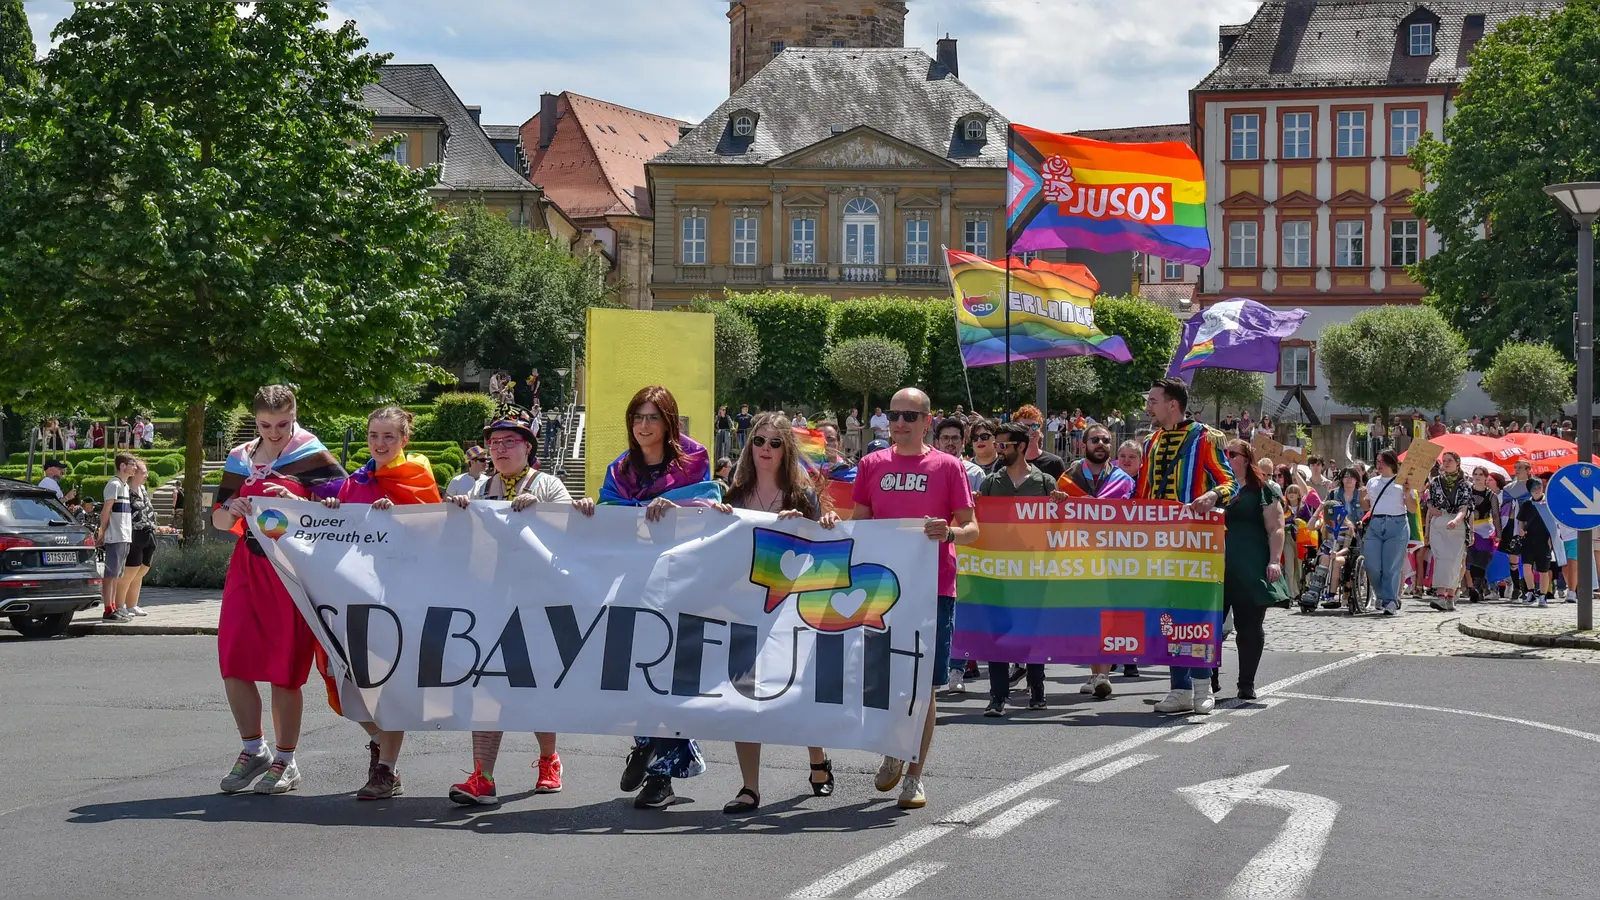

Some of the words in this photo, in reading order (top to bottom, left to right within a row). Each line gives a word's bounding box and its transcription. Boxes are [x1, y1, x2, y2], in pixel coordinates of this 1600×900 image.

[1069, 186, 1166, 221] JUSOS
[970, 303, 994, 312] CSD
[1531, 452, 1543, 460] DIE
[1015, 502, 1059, 520] WIR
[1064, 502, 1116, 521] SIND
[299, 514, 346, 528] Queer
[293, 529, 360, 544] Bayreuth
[363, 531, 389, 543] e.V.
[1046, 530, 1090, 548] WIR
[1095, 530, 1149, 548] SIND
[1154, 530, 1219, 551] BUNT.
[955, 553, 1023, 577] GEGEN
[1029, 558, 1085, 577] HASS
[1091, 558, 1140, 577] UND
[1146, 558, 1219, 579] HETZE.
[1171, 624, 1210, 641] JUSOS
[1103, 636, 1139, 651] SPD
[417, 604, 924, 717] BAYREUTH
